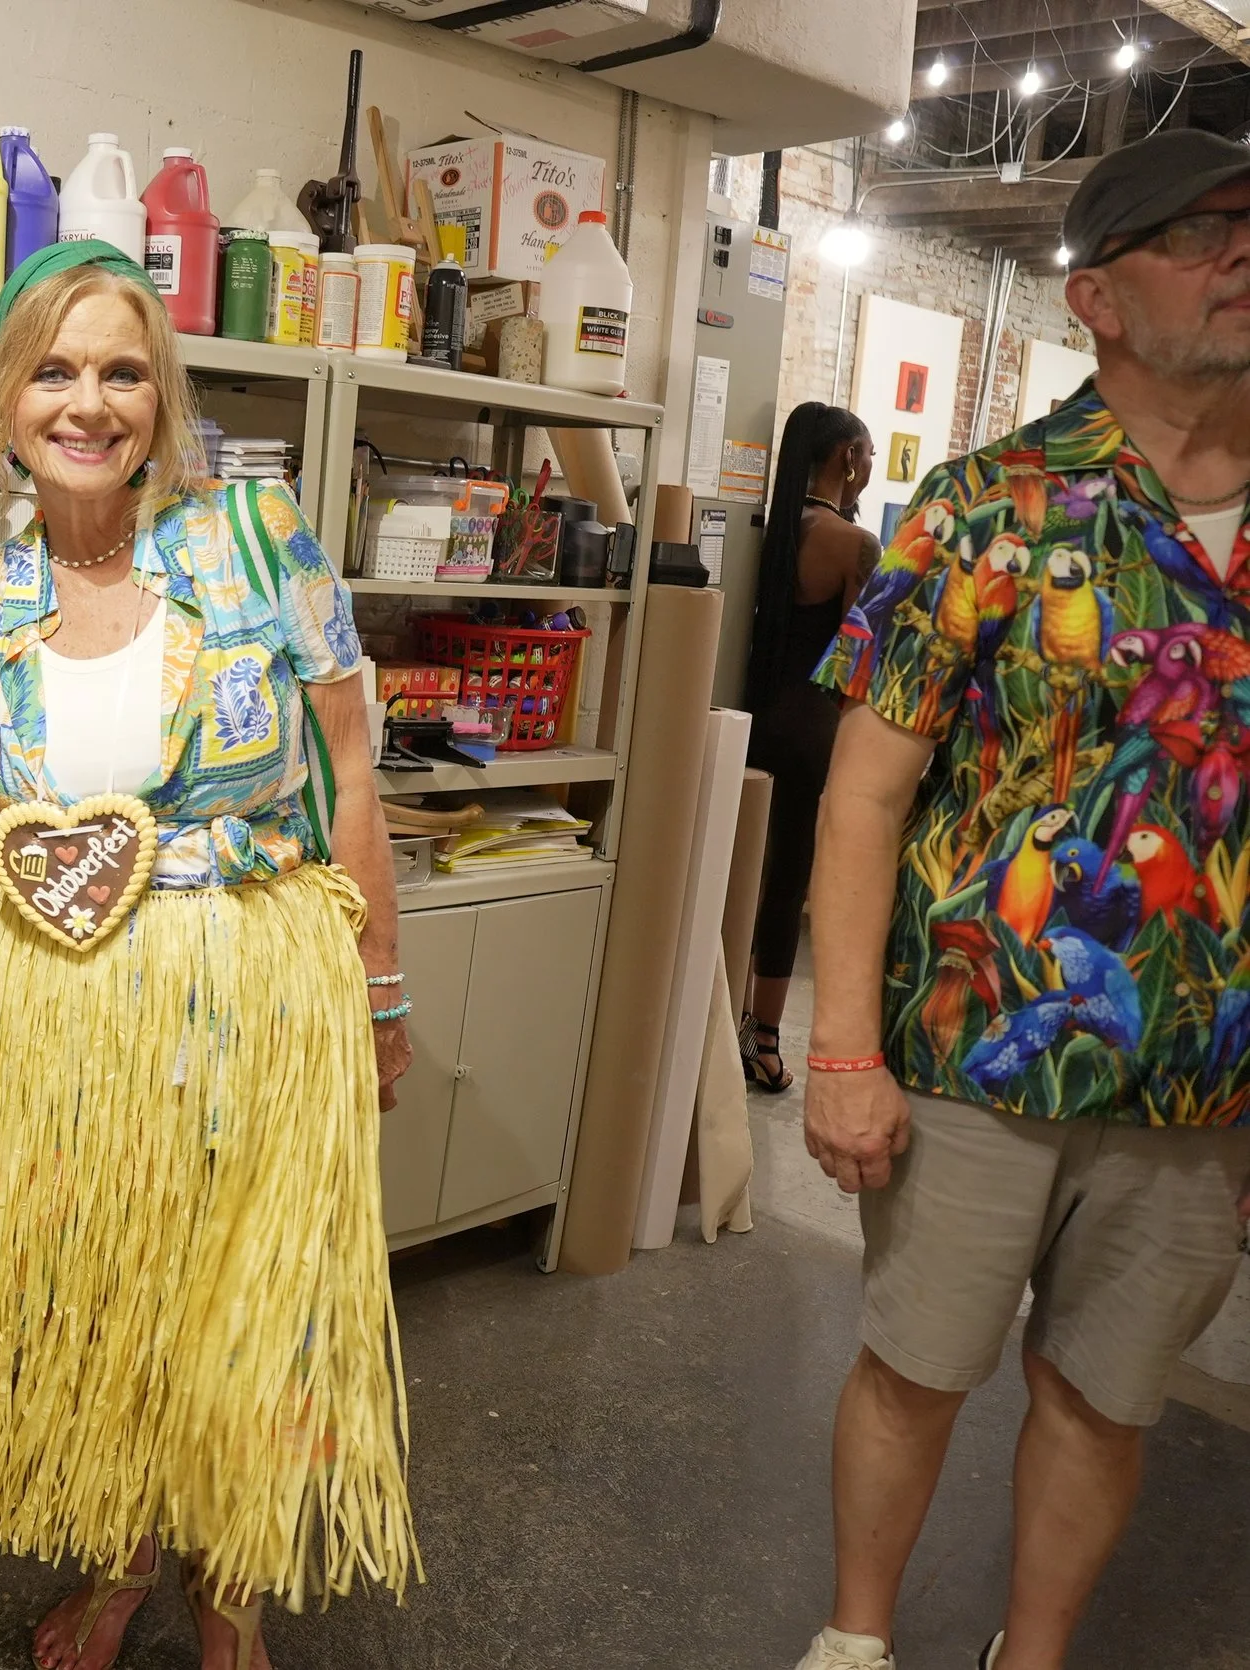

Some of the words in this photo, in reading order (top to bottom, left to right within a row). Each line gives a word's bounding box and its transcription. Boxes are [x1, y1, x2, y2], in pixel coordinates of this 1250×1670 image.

[598, 310, 619, 319] BLICK
[586, 325, 609, 335] WHITE
[31, 817, 137, 917] Oktoberfest
